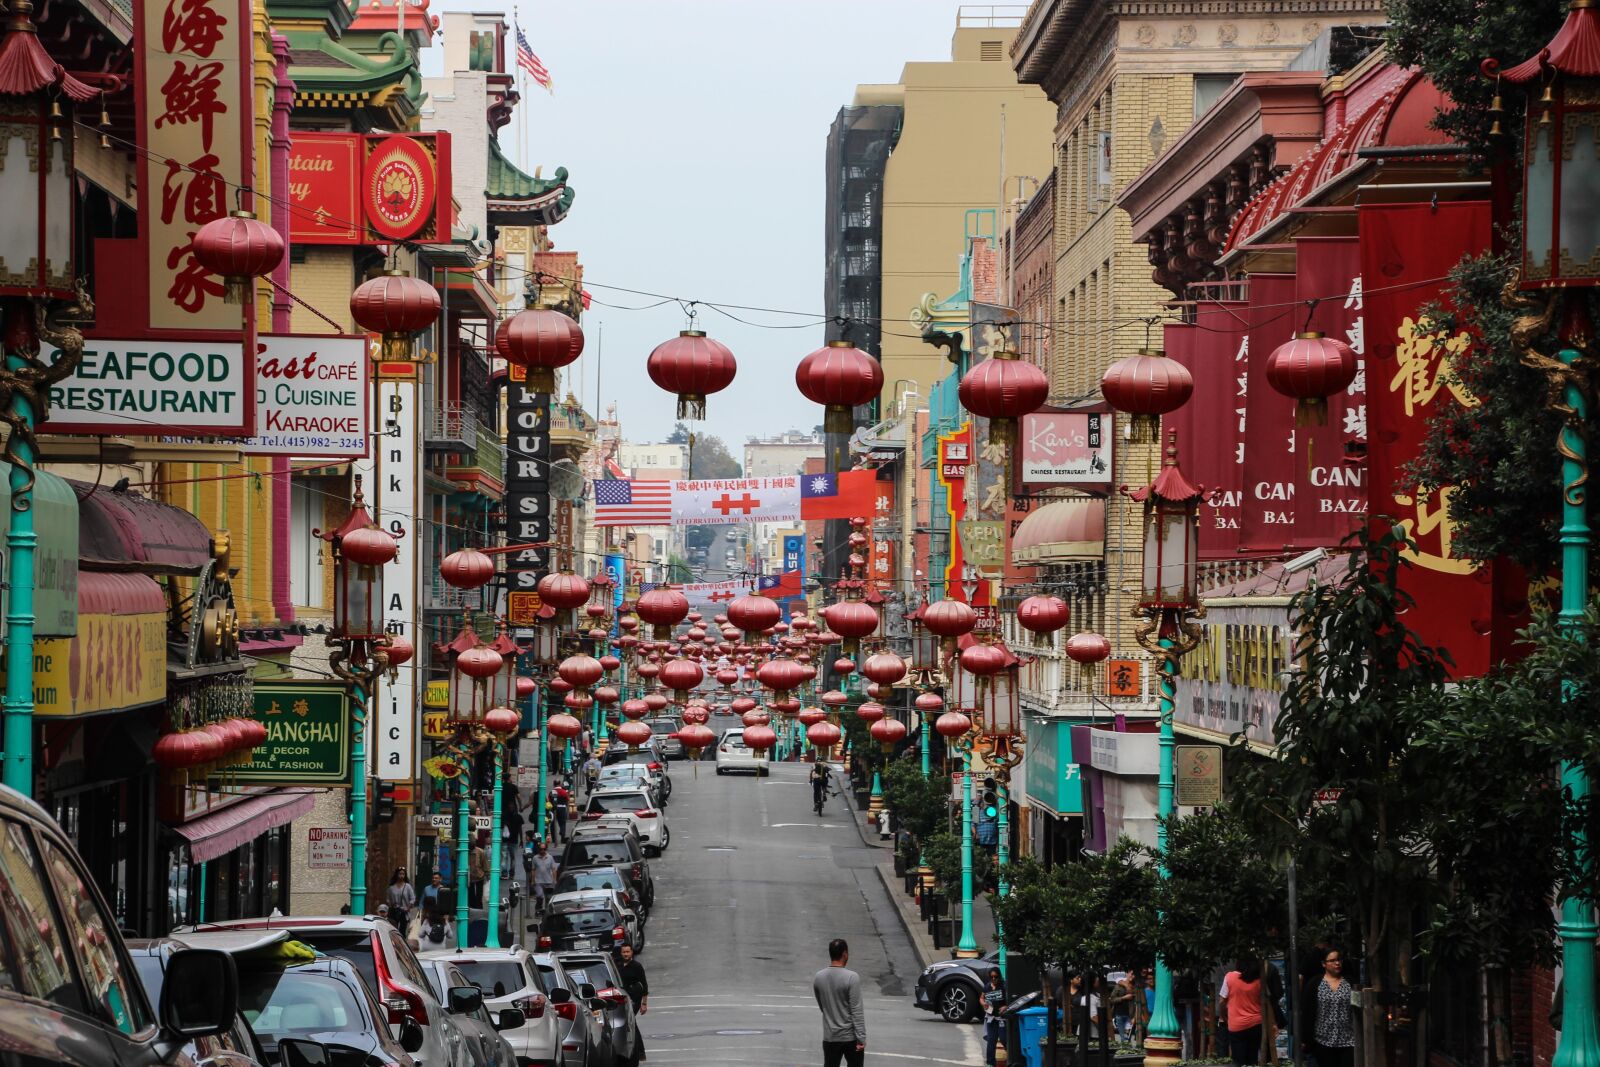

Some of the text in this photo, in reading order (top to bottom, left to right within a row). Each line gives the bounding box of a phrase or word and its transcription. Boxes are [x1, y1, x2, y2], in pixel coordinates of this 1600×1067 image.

[155, 0, 228, 313] 海鮮酒家
[317, 362, 358, 380] CAFÉ
[49, 387, 236, 413] RESTAURANT
[275, 383, 357, 407] CUISINE
[266, 409, 359, 432] KARAOKE
[517, 386, 541, 478] FOUR
[1029, 417, 1085, 456] Kan's
[943, 464, 966, 475] EAS
[676, 517, 724, 525] CELEBRATION
[744, 515, 778, 523] NATIONAL
[516, 497, 541, 587] SEAS
[264, 720, 339, 742] HANGHAI
[273, 747, 310, 755] DECOR
[232, 761, 324, 769] ENTAL FASHION
[310, 829, 348, 840] NO PARKING
[335, 852, 344, 860] FRI
